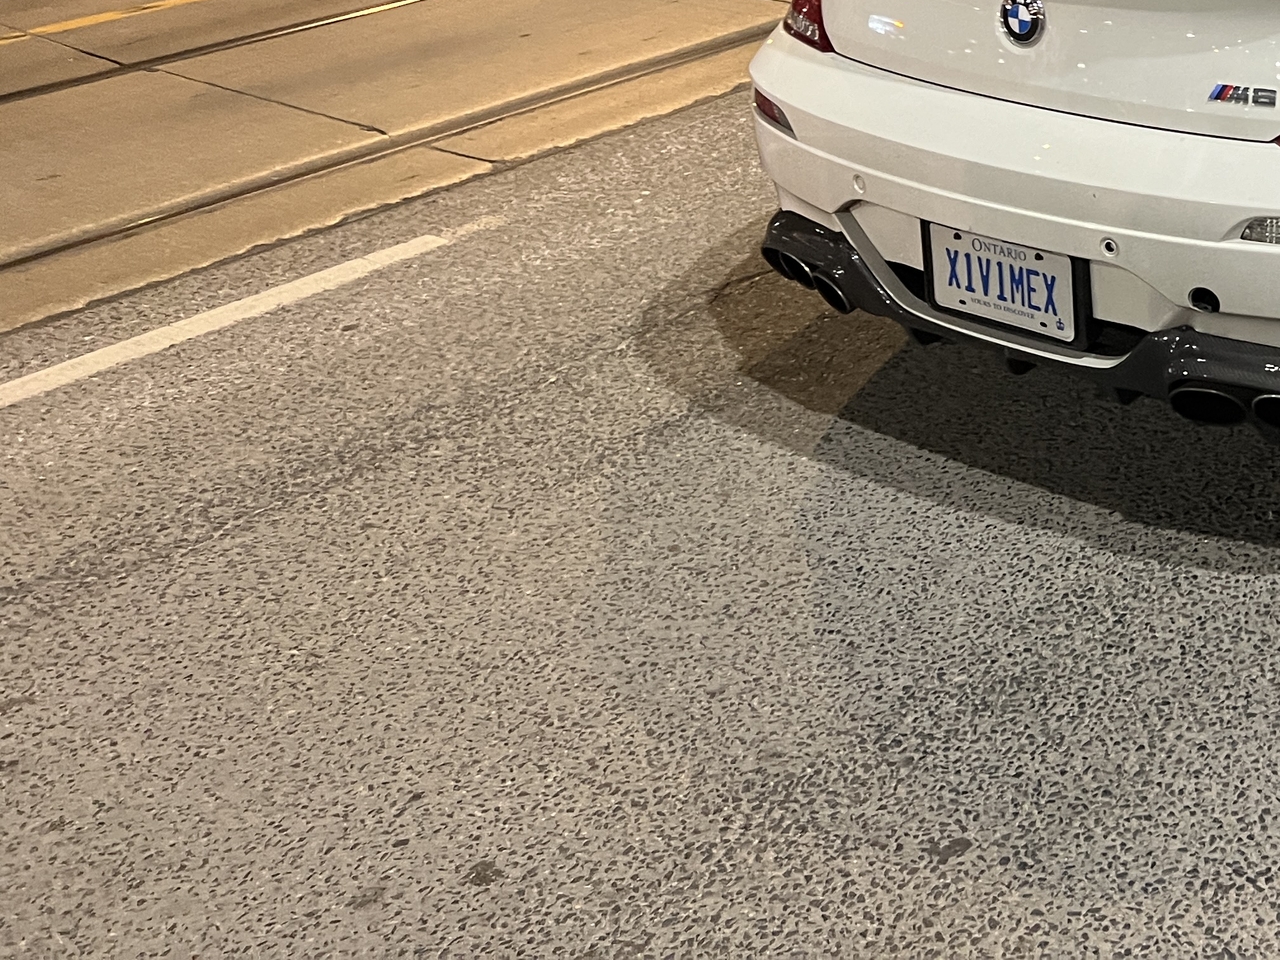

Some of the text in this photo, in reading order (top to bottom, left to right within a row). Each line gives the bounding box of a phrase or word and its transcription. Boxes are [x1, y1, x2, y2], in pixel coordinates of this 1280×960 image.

[1224, 85, 1277, 108] M6
[971, 238, 1027, 261] ONTARIO
[945, 247, 1058, 317] X1V1MEX
[971, 297, 1035, 320] YOURS TO DISCOVER
